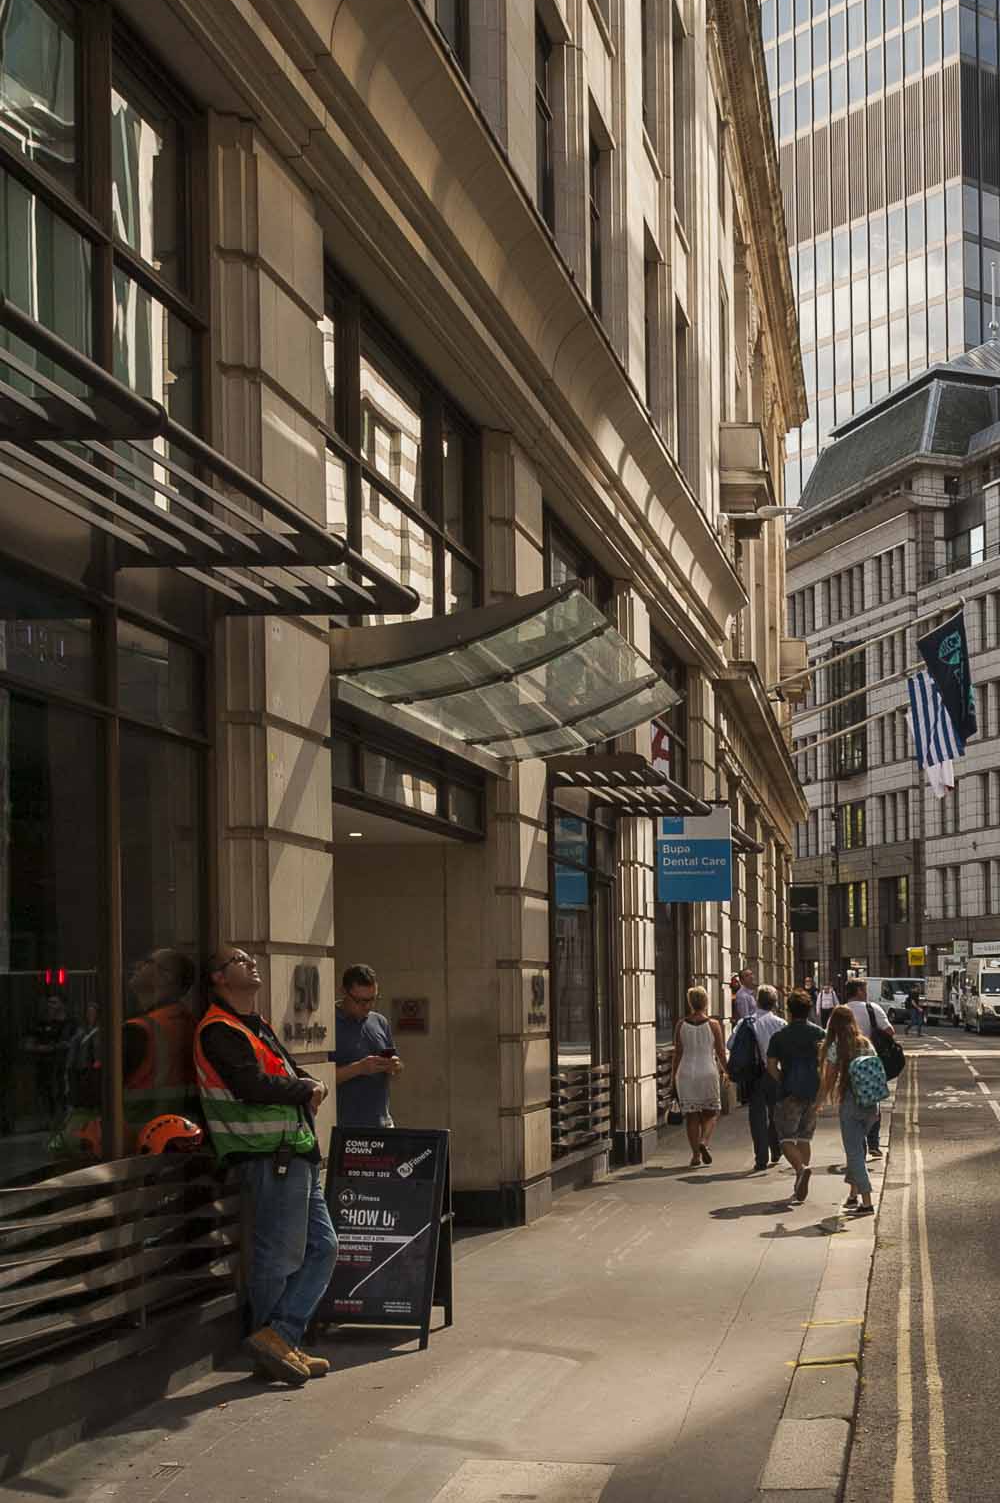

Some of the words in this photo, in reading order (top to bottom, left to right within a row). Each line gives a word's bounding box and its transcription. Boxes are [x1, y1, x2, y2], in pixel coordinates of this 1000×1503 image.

[663, 844, 690, 855] Bupa
[663, 857, 698, 866] Dental
[701, 857, 726, 866] Care
[345, 1140, 369, 1148] COME
[370, 1141, 385, 1149] ON
[408, 1148, 432, 1169] Fitness
[340, 1209, 380, 1226] SHOW
